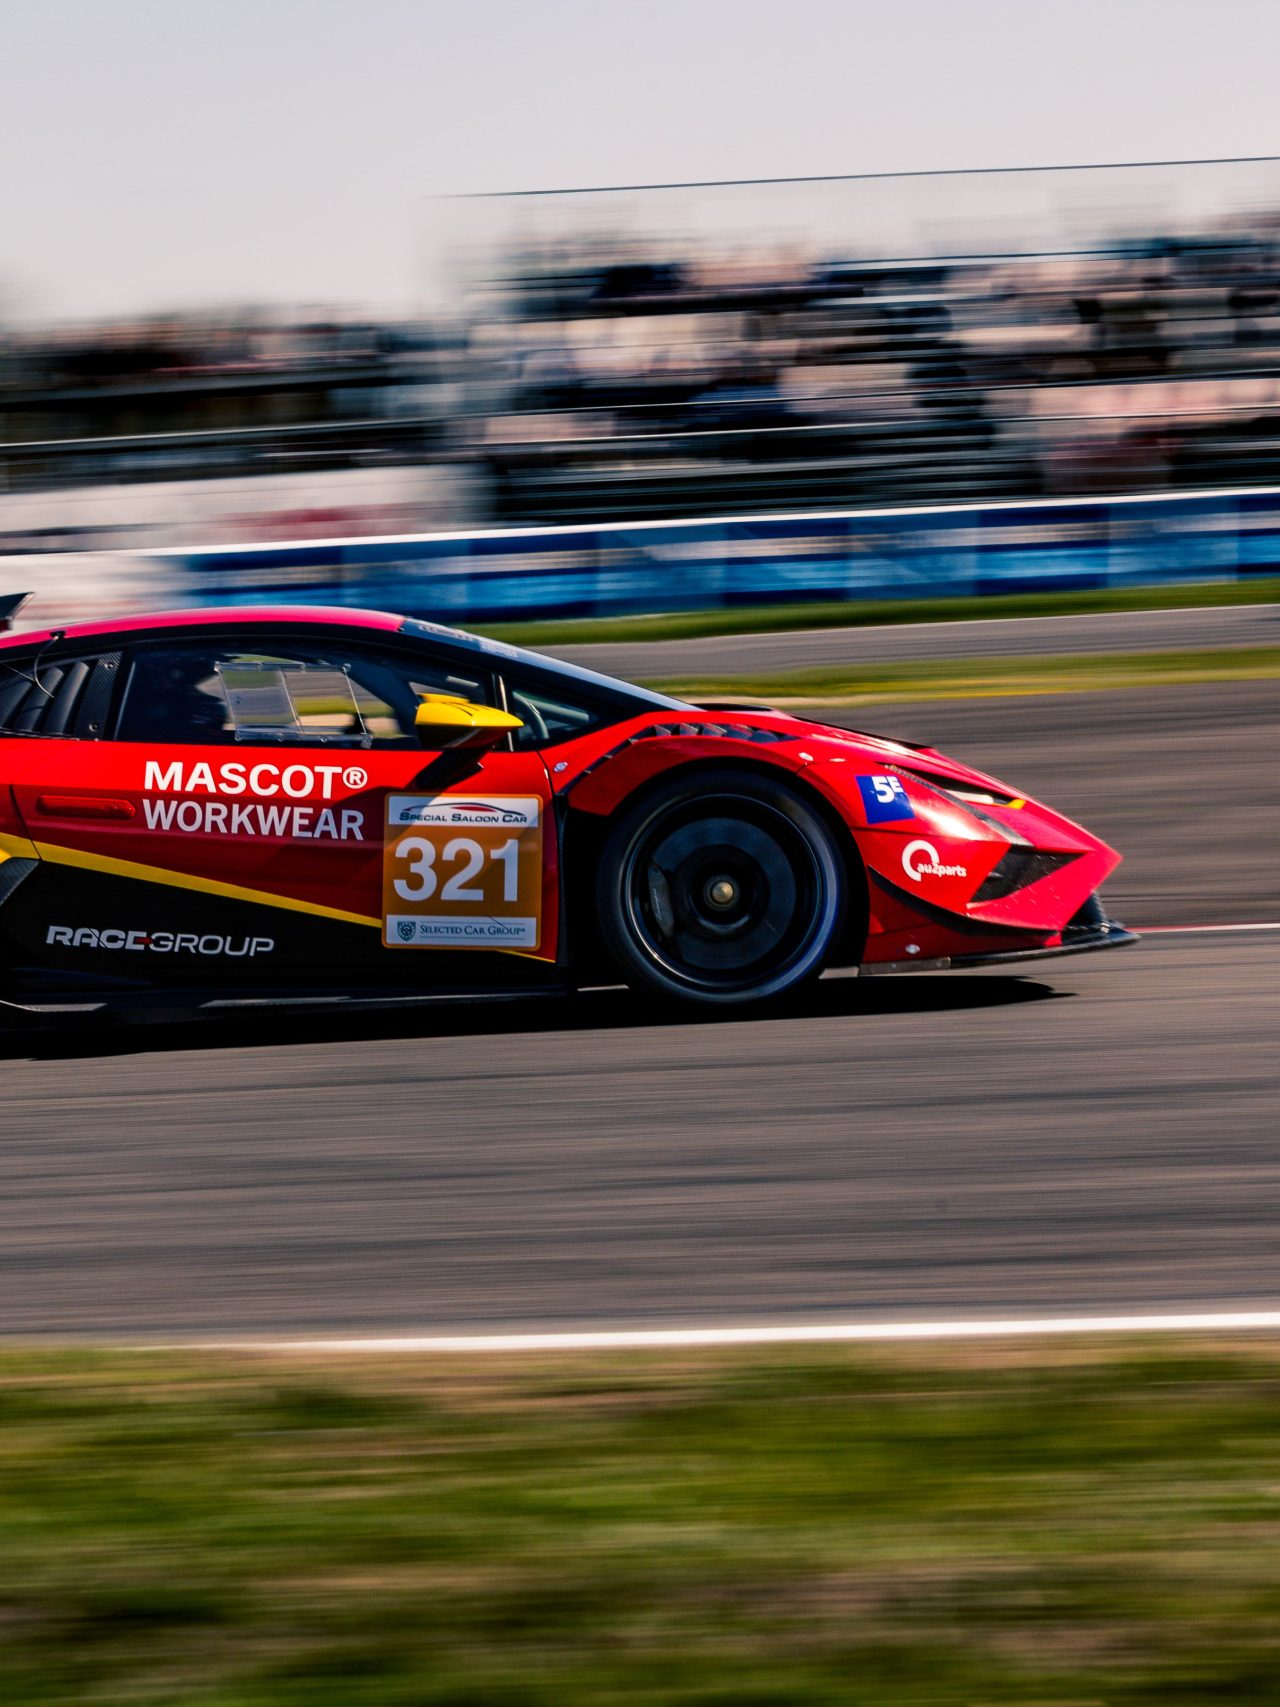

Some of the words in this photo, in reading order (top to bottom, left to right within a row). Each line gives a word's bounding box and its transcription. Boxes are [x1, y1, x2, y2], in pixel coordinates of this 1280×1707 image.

[142, 799, 364, 841] WORKWEAR
[399, 812, 448, 822] SPECIAL
[451, 813, 499, 823] SALOON
[502, 814, 528, 823] CAR
[393, 836, 519, 902] 321
[420, 924, 462, 934] SELECTED
[464, 925, 486, 935] CAR
